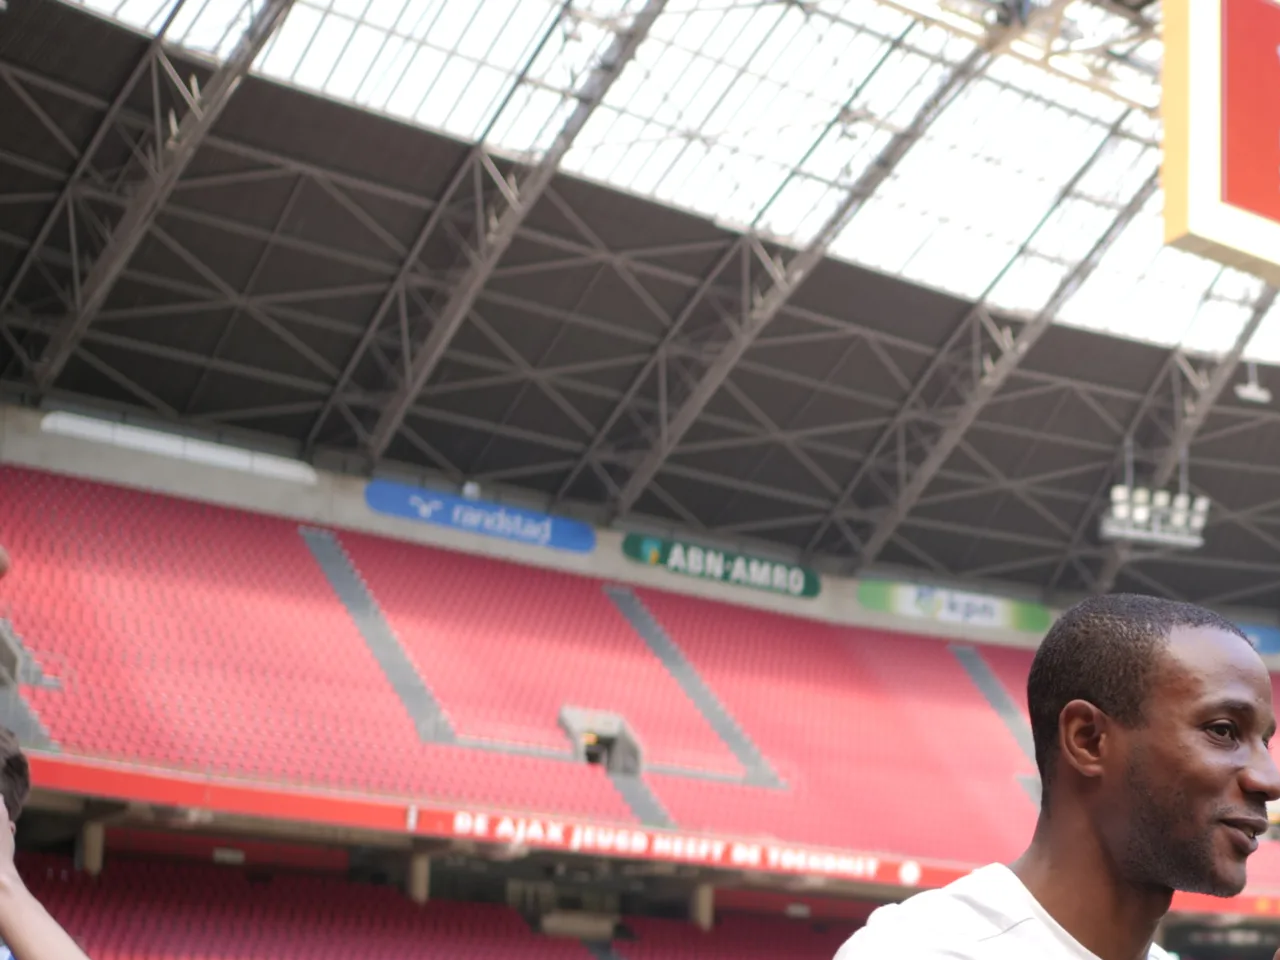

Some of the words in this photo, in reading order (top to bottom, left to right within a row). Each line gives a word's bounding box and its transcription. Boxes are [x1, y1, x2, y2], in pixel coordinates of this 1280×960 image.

[451, 502, 552, 544] randstad
[453, 811, 489, 837] DE
[495, 815, 563, 848] AJAX
[569, 824, 649, 853] JEUGD
[653, 834, 723, 862] HEEFT
